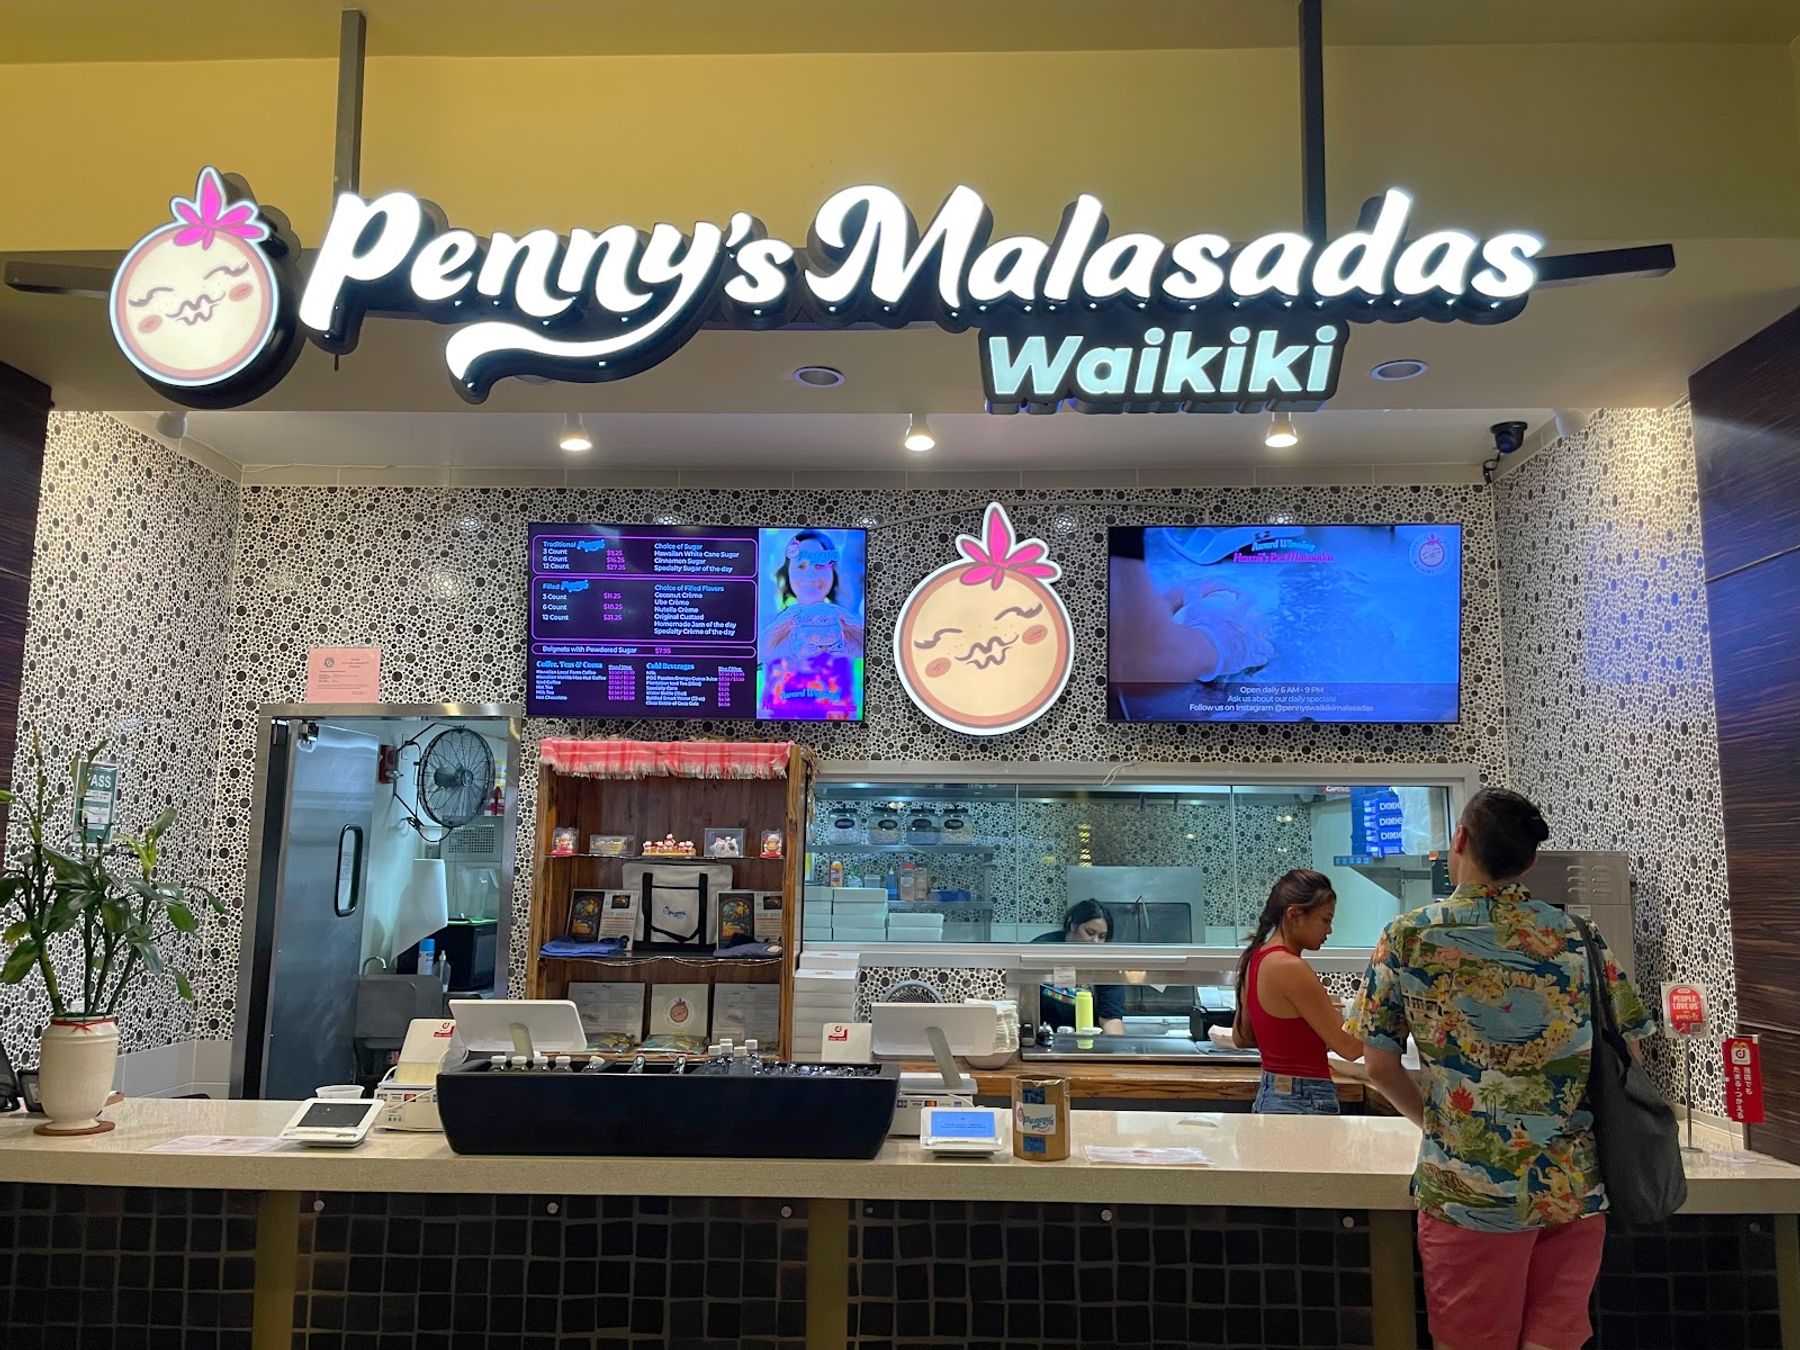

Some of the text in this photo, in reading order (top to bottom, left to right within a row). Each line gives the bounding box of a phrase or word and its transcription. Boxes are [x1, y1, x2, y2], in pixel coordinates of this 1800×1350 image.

[299, 183, 1543, 381] Penny's Malasadas
[987, 325, 1338, 395] Waikiki
[1240, 686, 1260, 694] Open
[1262, 686, 1280, 695] daily
[1288, 695, 1304, 703] daily
[1236, 704, 1274, 712] Instagram
[87, 773, 111, 788] ASS
